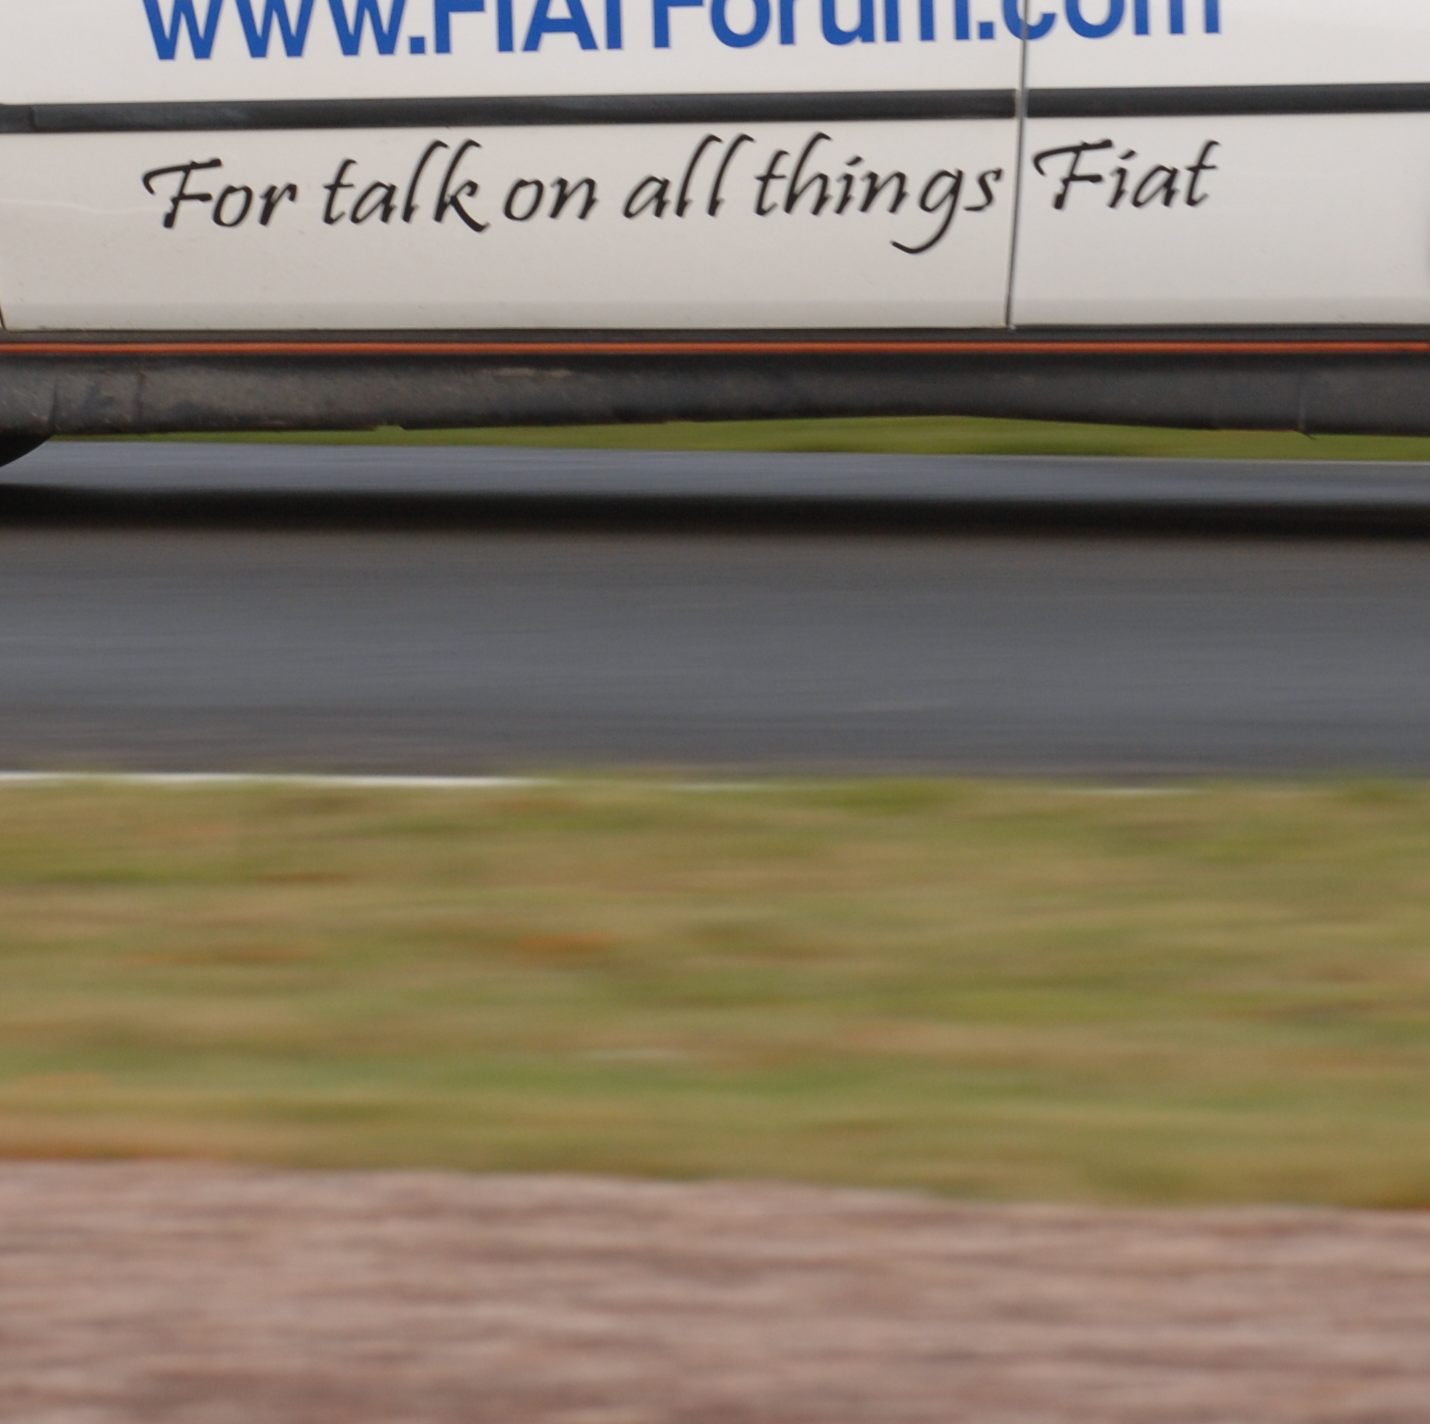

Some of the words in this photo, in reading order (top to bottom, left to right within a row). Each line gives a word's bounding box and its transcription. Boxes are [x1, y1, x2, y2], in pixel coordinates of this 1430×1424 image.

[142, 157, 298, 229] For
[323, 138, 489, 233] talk
[503, 176, 598, 222] on
[623, 132, 755, 219] all
[755, 131, 1004, 255] things
[1032, 138, 1220, 211] Fiat
